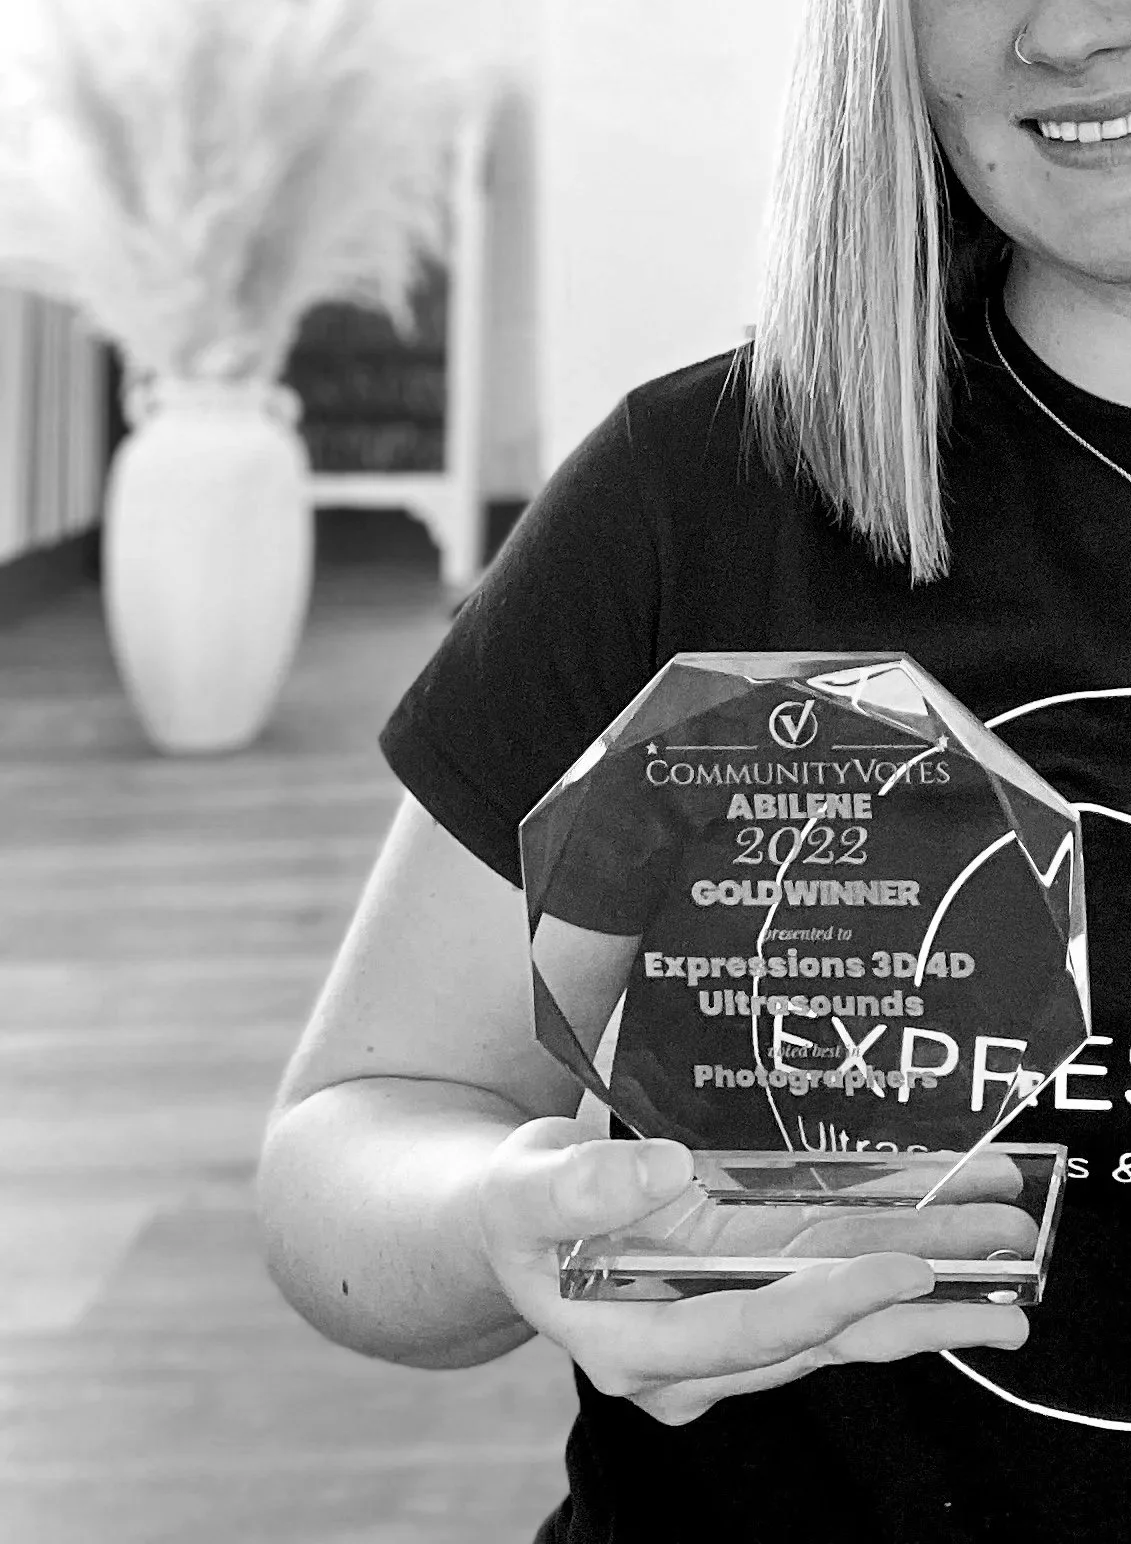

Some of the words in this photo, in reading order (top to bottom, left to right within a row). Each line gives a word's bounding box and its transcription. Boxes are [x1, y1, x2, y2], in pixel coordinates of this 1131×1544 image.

[726, 793, 873, 820] ABILENE
[732, 826, 868, 866] 2022
[691, 879, 783, 906] GOLD
[784, 879, 920, 906] WINNER
[644, 948, 867, 987] Expressions
[872, 951, 918, 978] 3D
[924, 951, 976, 979] 4D
[699, 989, 925, 1017] Ultrasounds
[694, 1064, 939, 1096] Photographers
